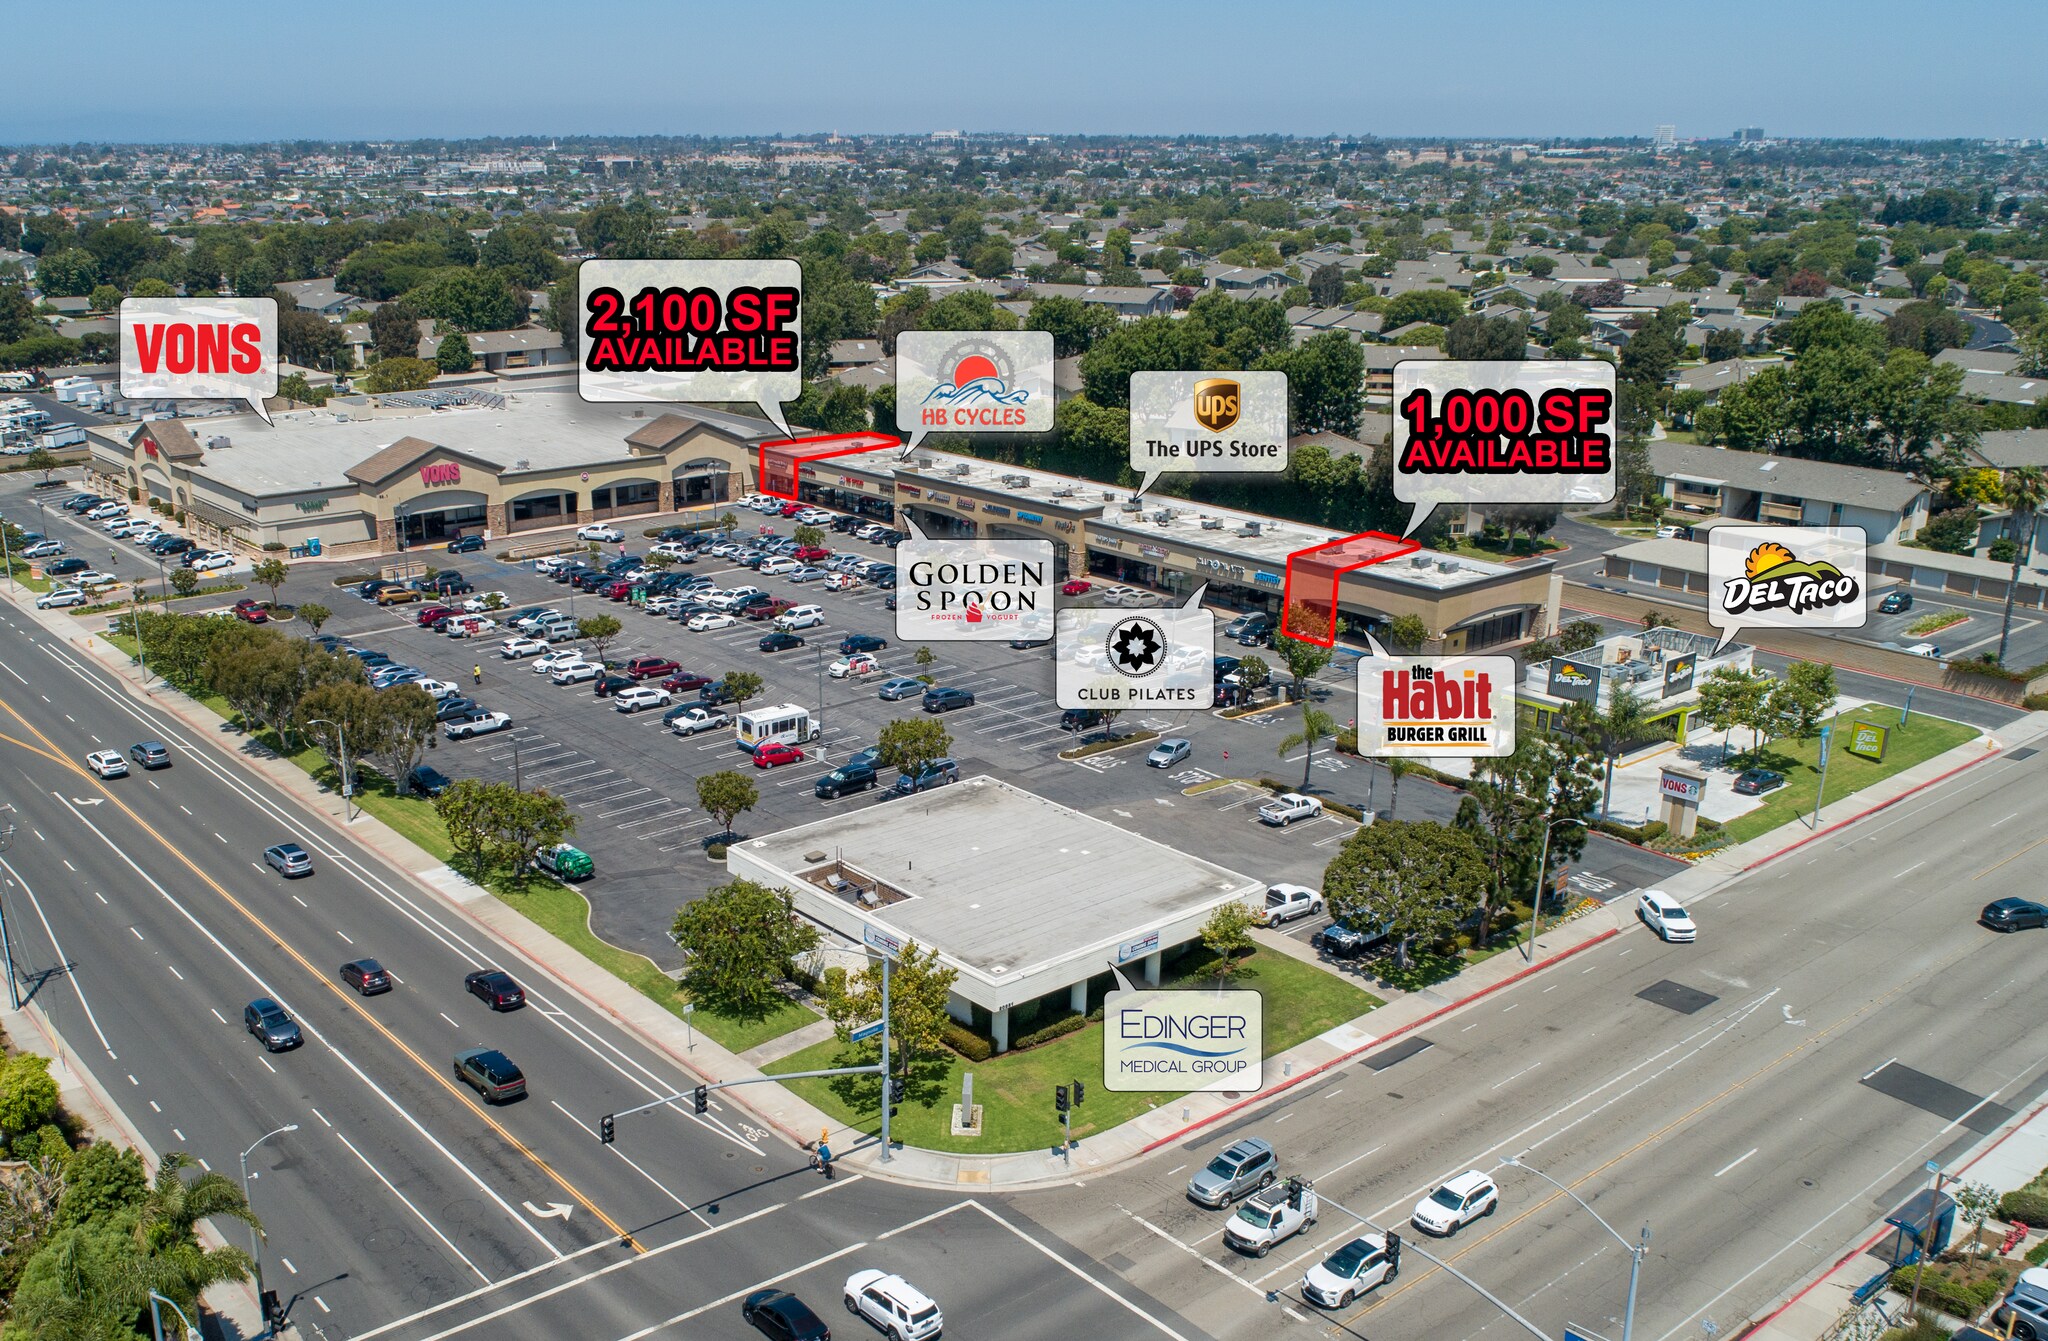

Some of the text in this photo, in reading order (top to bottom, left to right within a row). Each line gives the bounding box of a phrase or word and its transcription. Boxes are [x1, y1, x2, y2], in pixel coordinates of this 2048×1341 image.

[419, 462, 461, 484] VONS
[1253, 572, 1281, 584] DENTIST
[1856, 732, 1878, 743] DEL
[1855, 741, 1878, 752] TACO
[1168, 770, 1212, 784] STOP
[1662, 777, 1688, 794] VONS
